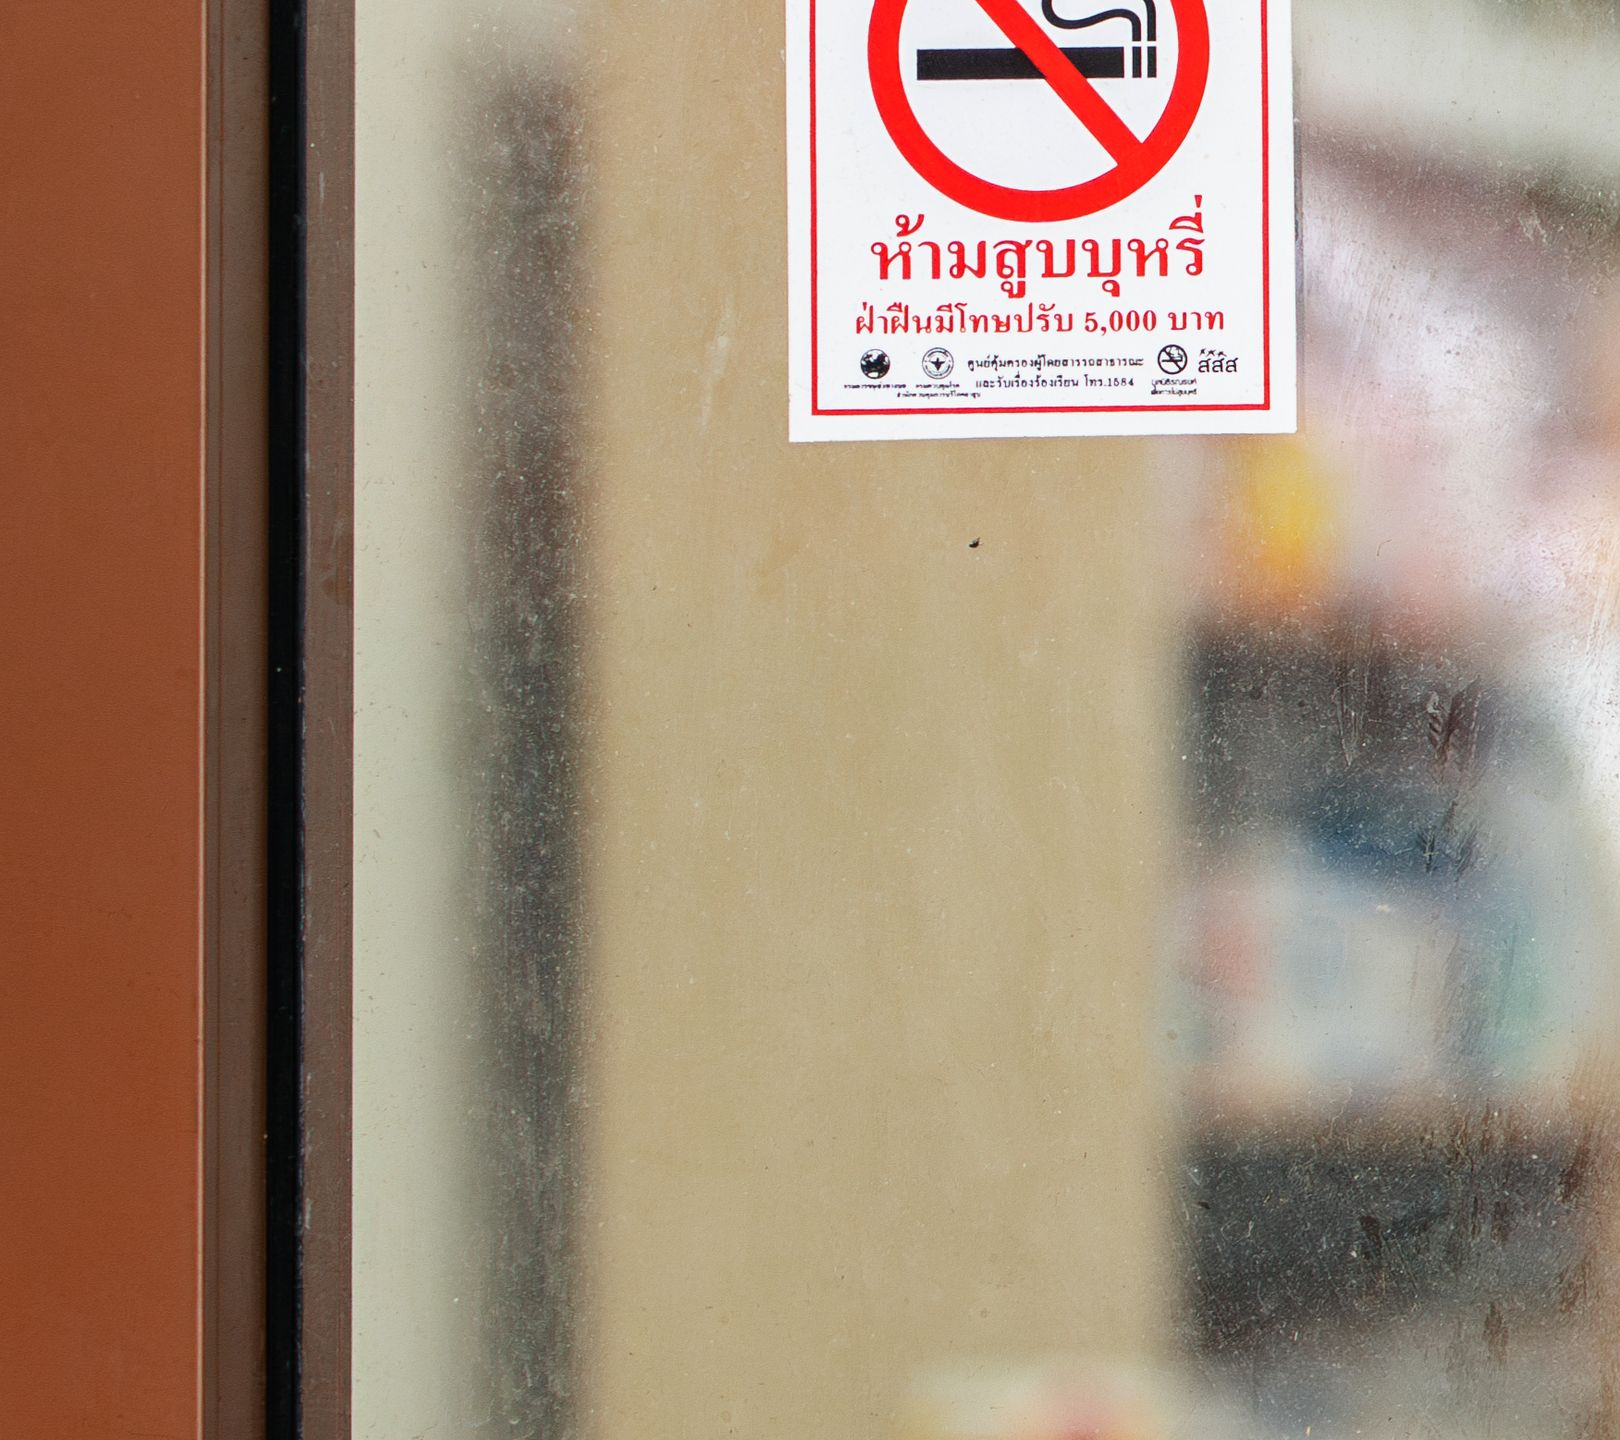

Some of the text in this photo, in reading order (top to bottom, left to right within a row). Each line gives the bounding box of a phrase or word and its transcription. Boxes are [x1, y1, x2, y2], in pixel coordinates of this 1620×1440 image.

[870, 194, 1206, 299] ห้ามสูบบุหรี่
[855, 301, 1225, 336] ฝ่าฝืนมีโทษปรับ 5,000 บาท
